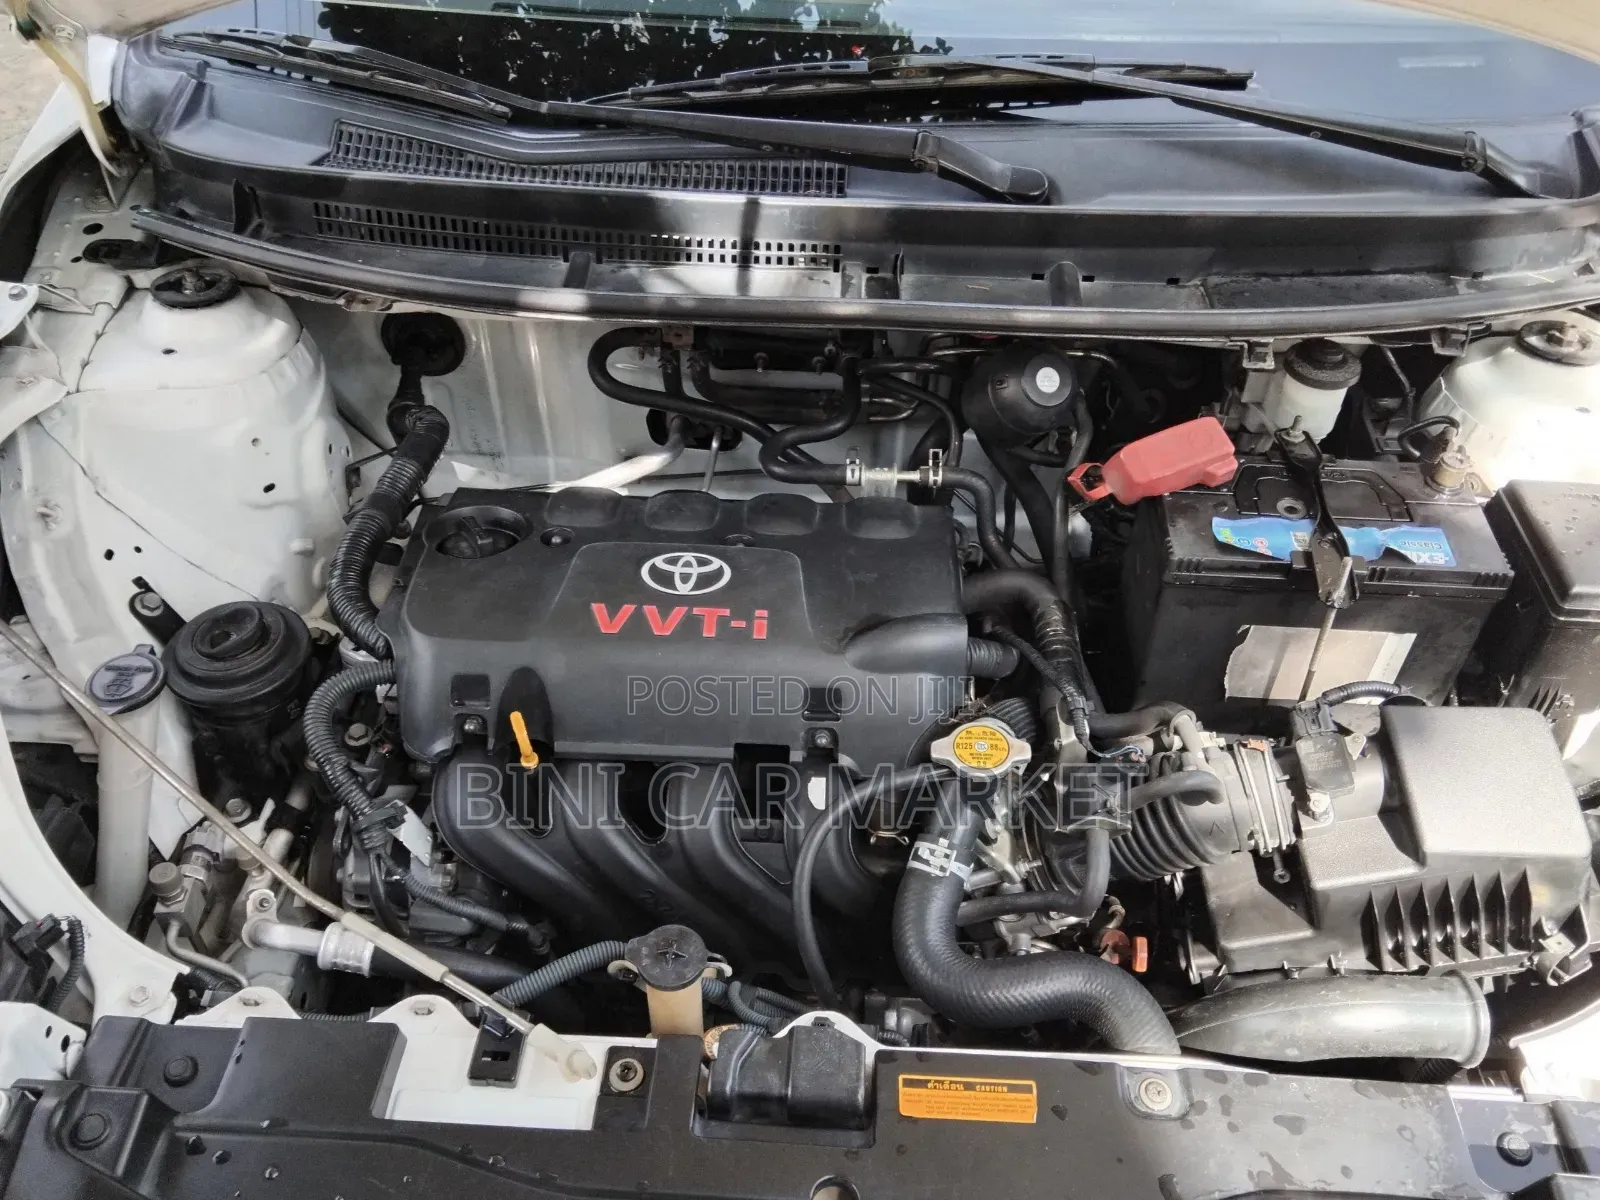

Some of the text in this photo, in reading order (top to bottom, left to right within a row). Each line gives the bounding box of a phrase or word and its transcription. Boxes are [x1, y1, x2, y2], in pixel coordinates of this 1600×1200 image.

[1400, 541, 1443, 551] Classic
[591, 603, 768, 640] VVT-i
[975, 1085, 1008, 1093] CAUTION
